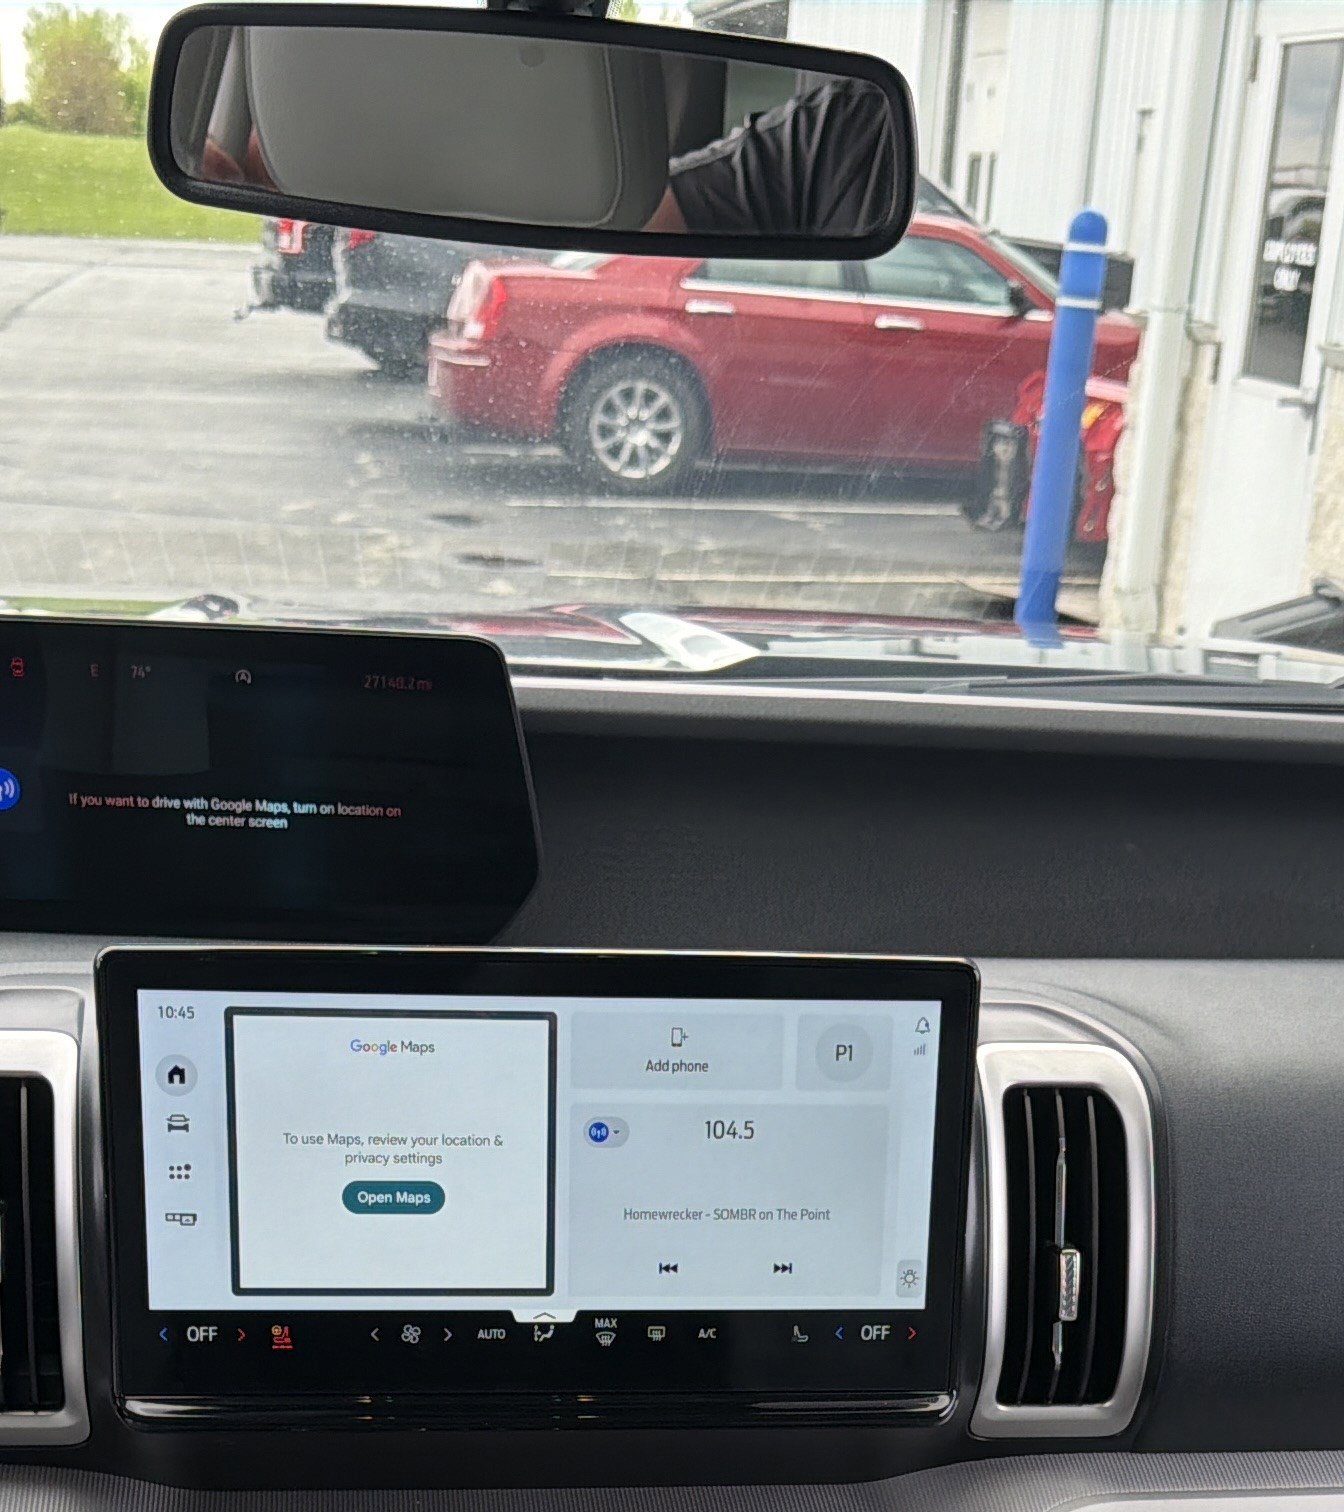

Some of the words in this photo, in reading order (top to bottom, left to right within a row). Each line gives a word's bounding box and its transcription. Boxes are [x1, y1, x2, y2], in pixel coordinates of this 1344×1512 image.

[68, 792, 78, 805] If
[80, 794, 103, 808] you
[105, 795, 135, 808] want
[137, 795, 150, 808] to
[152, 796, 181, 809] drive
[183, 797, 209, 810] with
[211, 796, 252, 813] Google
[255, 799, 291, 815] Maps,
[293, 801, 318, 814] turn
[320, 804, 335, 815] on
[337, 802, 384, 816] location
[386, 806, 402, 817] on
[186, 812, 205, 826] the
[208, 814, 246, 828] center
[248, 817, 289, 829] screen
[158, 1006, 195, 1020] 10:45
[350, 1039, 398, 1056] Google
[400, 1040, 435, 1056] Maps
[835, 1044, 854, 1061] P1
[645, 1059, 670, 1073] Add
[672, 1059, 709, 1074] phone
[705, 1120, 755, 1140] 104.5
[283, 1133, 299, 1146] To
[301, 1135, 324, 1146] use
[327, 1133, 365, 1149] Maps,
[367, 1133, 408, 1147] review
[410, 1135, 439, 1149] your
[441, 1133, 491, 1147] location
[493, 1134, 504, 1147] &
[344, 1152, 390, 1167] privacy
[392, 1152, 443, 1167] settings
[357, 1191, 393, 1207] Open
[395, 1191, 432, 1207] Maps
[623, 1208, 703, 1221] Homewrecker
[713, 1208, 757, 1221] SOMBR
[758, 1211, 774, 1221] on
[776, 1208, 798, 1221] The
[800, 1208, 831, 1221] Point
[594, 1318, 618, 1328] MAX
[186, 1326, 218, 1342] OFF
[477, 1328, 506, 1340] AUTO
[698, 1328, 717, 1340] A/C
[860, 1325, 891, 1341] OFF
